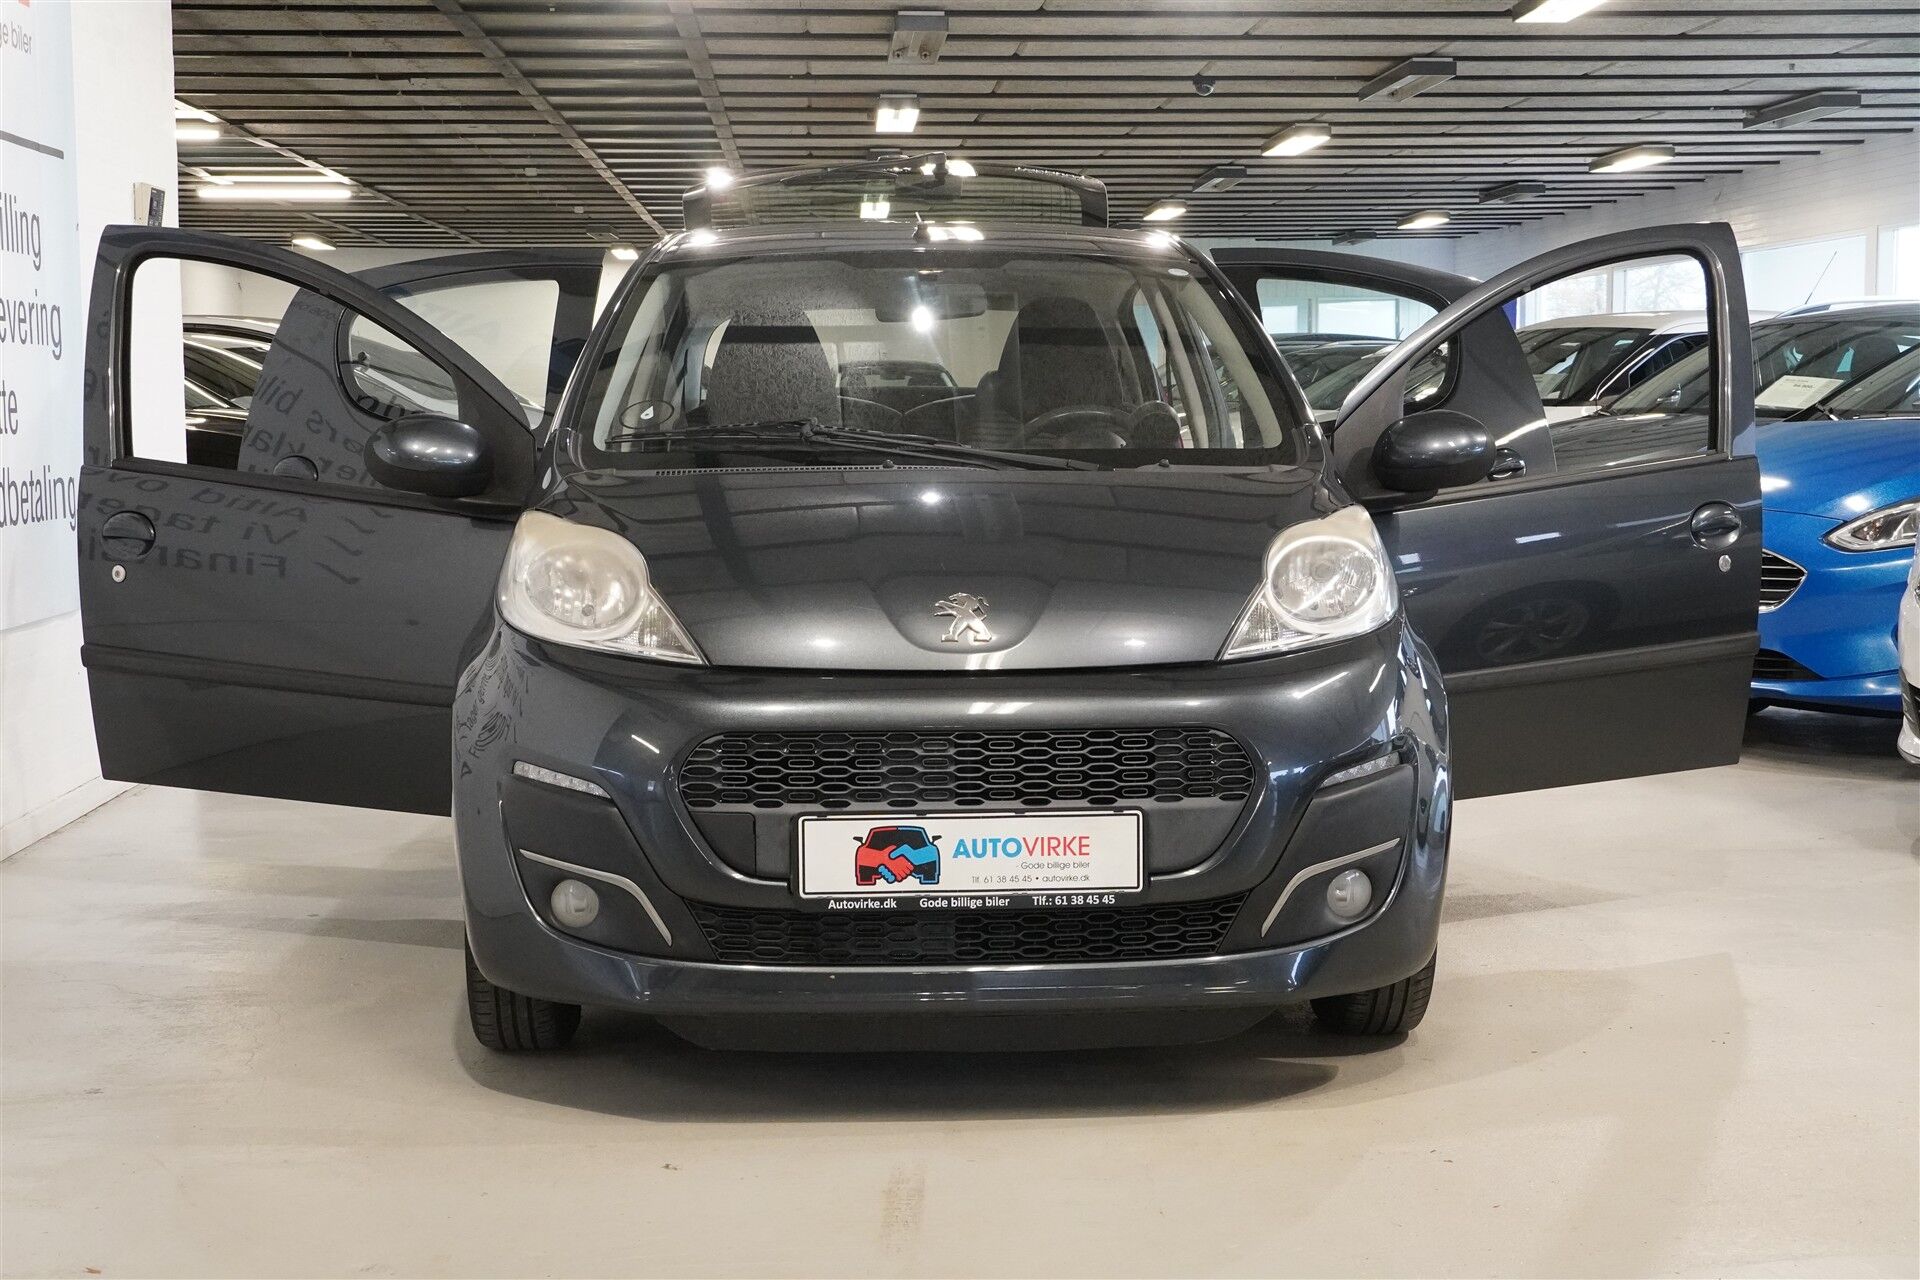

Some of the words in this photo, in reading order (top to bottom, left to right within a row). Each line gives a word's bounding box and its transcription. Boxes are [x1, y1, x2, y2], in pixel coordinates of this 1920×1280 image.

[11, 21, 32, 55] biler
[0, 289, 62, 360] evering
[0, 379, 18, 435] te
[0, 465, 76, 531] dbetaling
[952, 836, 1090, 859] AUTOVIRKE
[983, 875, 993, 883] 61
[996, 875, 1007, 883] 38
[1009, 875, 1020, 883] 45
[1021, 874, 1033, 882] 45
[1041, 873, 1090, 883] autovirke.dk
[1020, 861, 1045, 870] Gode
[1046, 861, 1071, 870] billige
[1072, 860, 1090, 869] biler
[827, 897, 898, 910] Autovirke.dk
[919, 898, 948, 908] Gode
[950, 897, 983, 909] billige
[985, 896, 1010, 907] biler
[1031, 895, 1053, 906] Tlf.:
[1054, 895, 1068, 906] 61
[1070, 895, 1084, 905] 38
[1086, 895, 1100, 905] 45
[1102, 894, 1116, 904] 45
